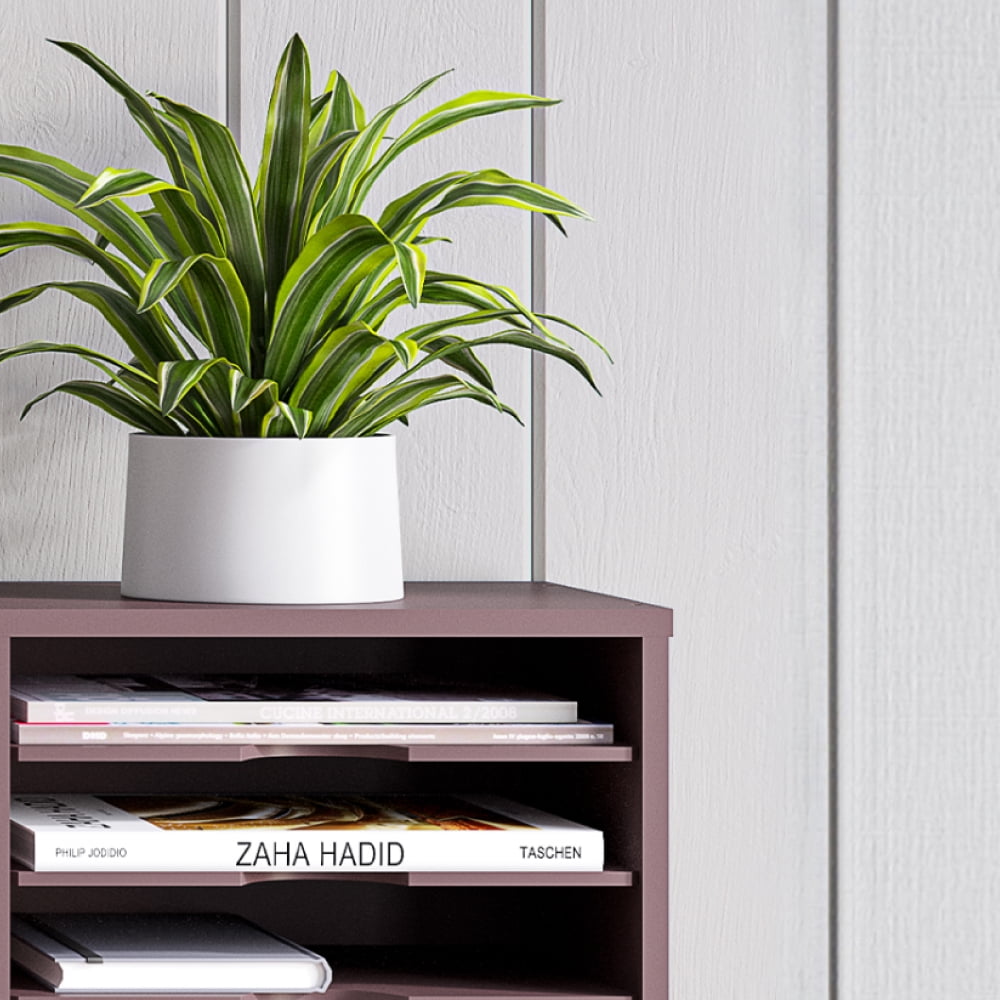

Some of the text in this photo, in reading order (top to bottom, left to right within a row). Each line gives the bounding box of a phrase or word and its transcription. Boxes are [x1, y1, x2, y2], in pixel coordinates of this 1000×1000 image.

[260, 706, 322, 720] CUCINE
[327, 706, 458, 720] INTERNATIONAL
[55, 847, 128, 858] PHILIP JODIDIO
[236, 841, 404, 867] ZAHA HADID
[519, 845, 582, 860] TASCHEN
